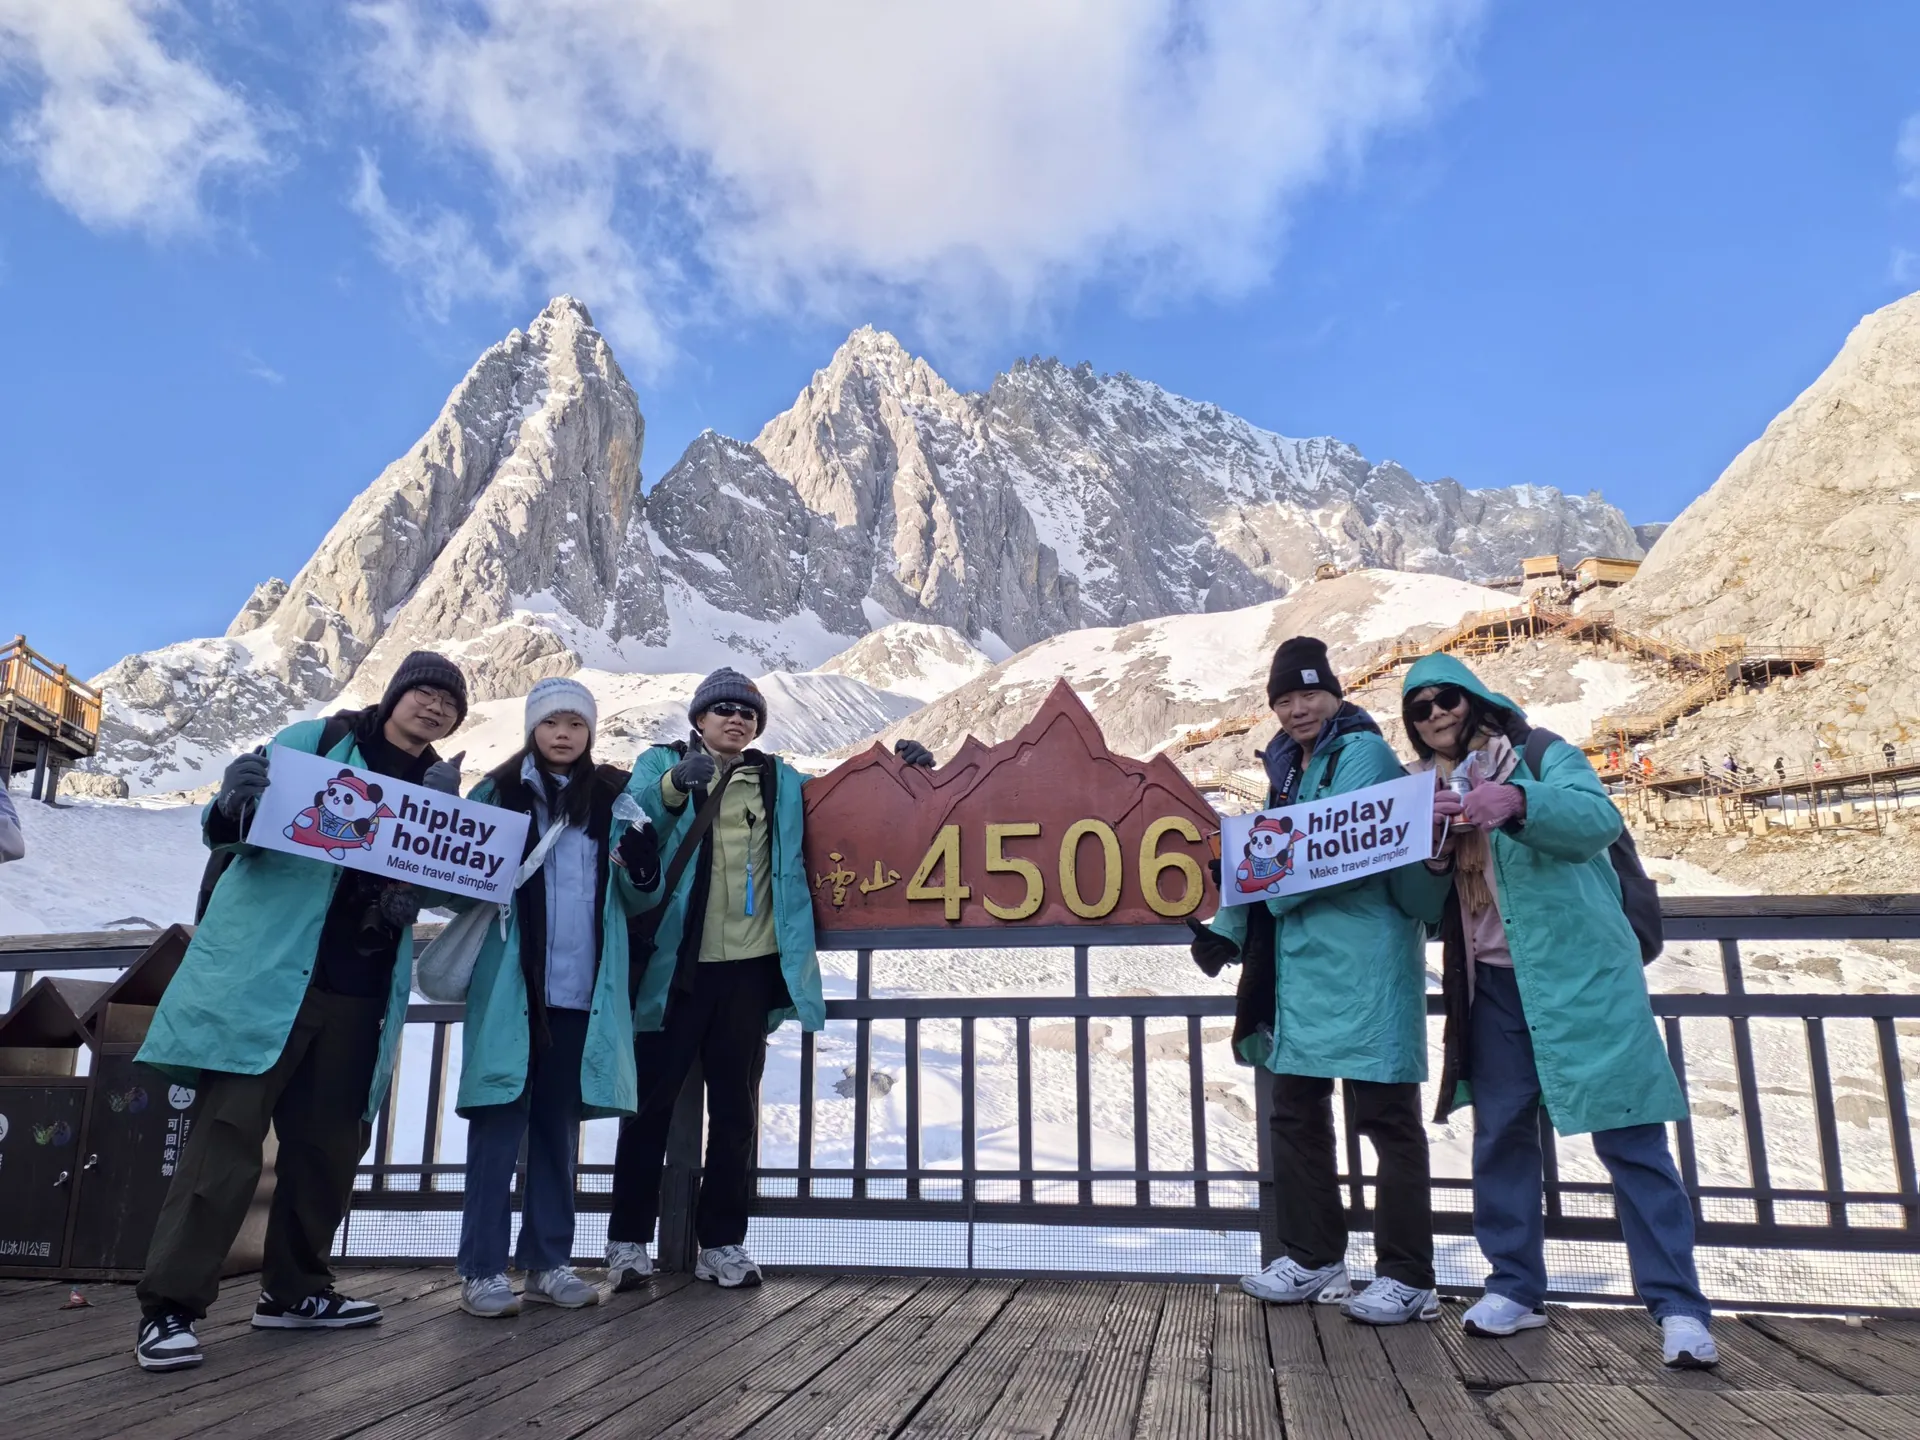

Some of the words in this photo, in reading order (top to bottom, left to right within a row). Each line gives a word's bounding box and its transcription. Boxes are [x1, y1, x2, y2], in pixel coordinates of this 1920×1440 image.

[1282, 766, 1296, 793] SONY
[400, 794, 496, 846] hiplay
[1308, 798, 1394, 834] hiplay
[392, 823, 505, 878] holiday
[1307, 822, 1410, 862] holiday
[386, 854, 419, 874] Make
[422, 866, 455, 882] travel
[457, 875, 498, 892] simpler
[906, 815, 1204, 921] 4506
[1309, 865, 1339, 880] Make
[1341, 857, 1370, 872] travel
[1372, 847, 1409, 865] simpler
[161, 1118, 179, 1176] 可回收物
